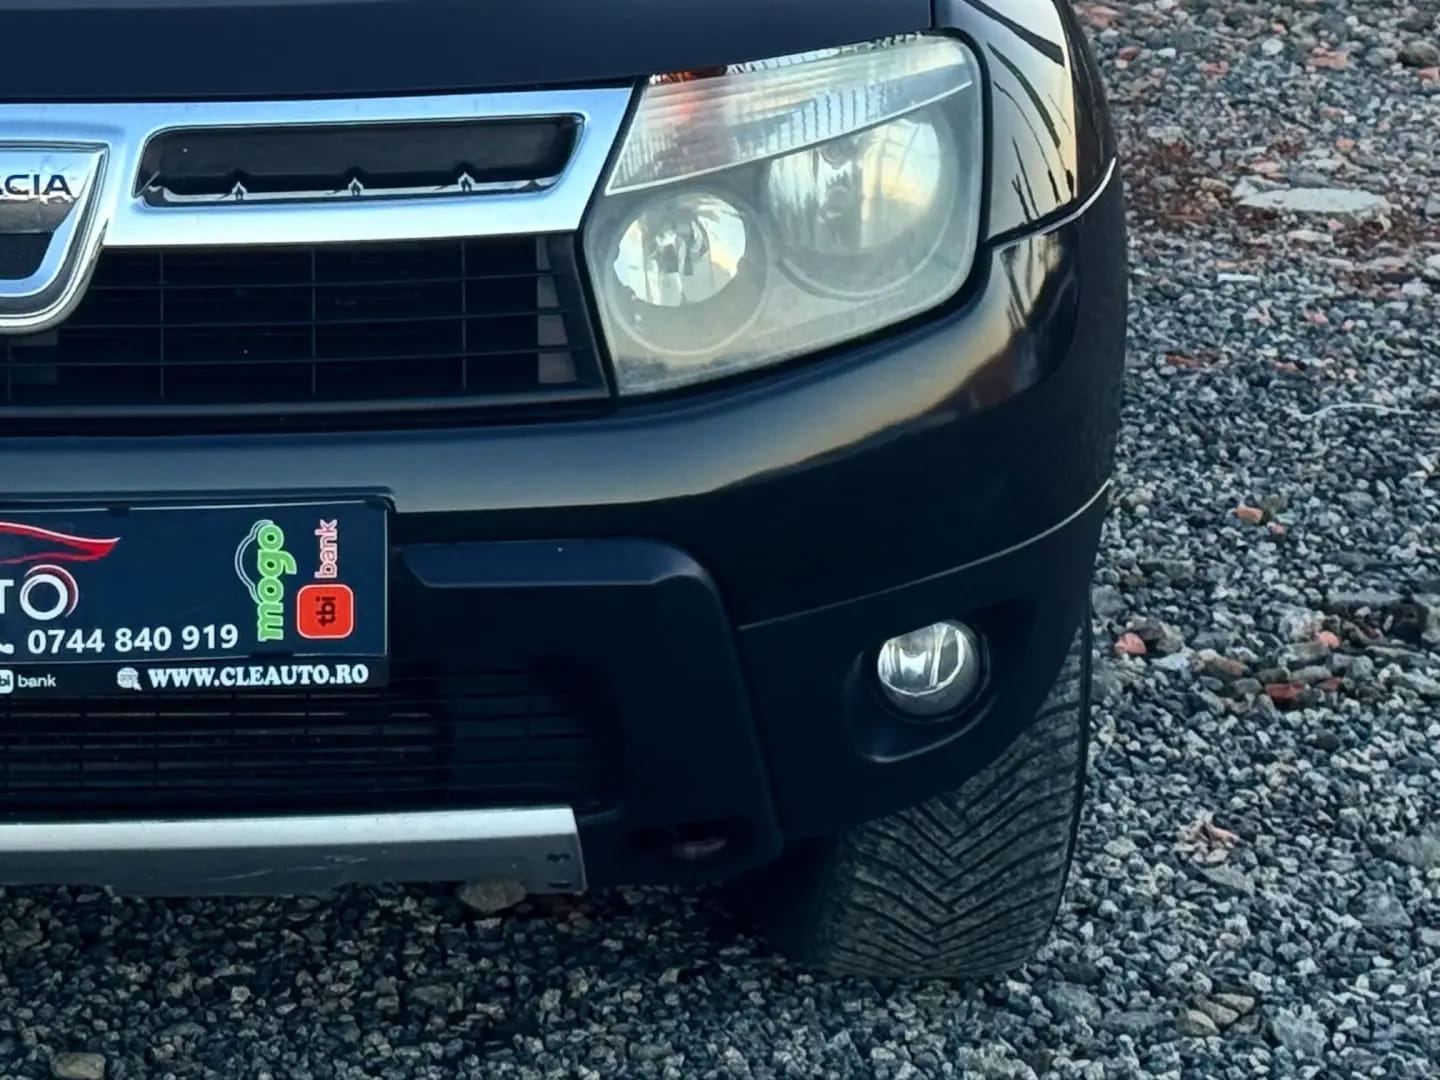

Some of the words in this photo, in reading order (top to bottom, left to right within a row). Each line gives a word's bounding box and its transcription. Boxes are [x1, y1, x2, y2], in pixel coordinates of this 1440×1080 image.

[314, 519, 338, 579] bank
[257, 524, 298, 642] mogo
[314, 595, 336, 627] tbi
[26, 628, 106, 654] 0744
[114, 626, 172, 653] 840
[181, 623, 240, 651] 919
[17, 673, 58, 689] bank
[147, 663, 370, 689] WWW.CLEAUTO.RO
